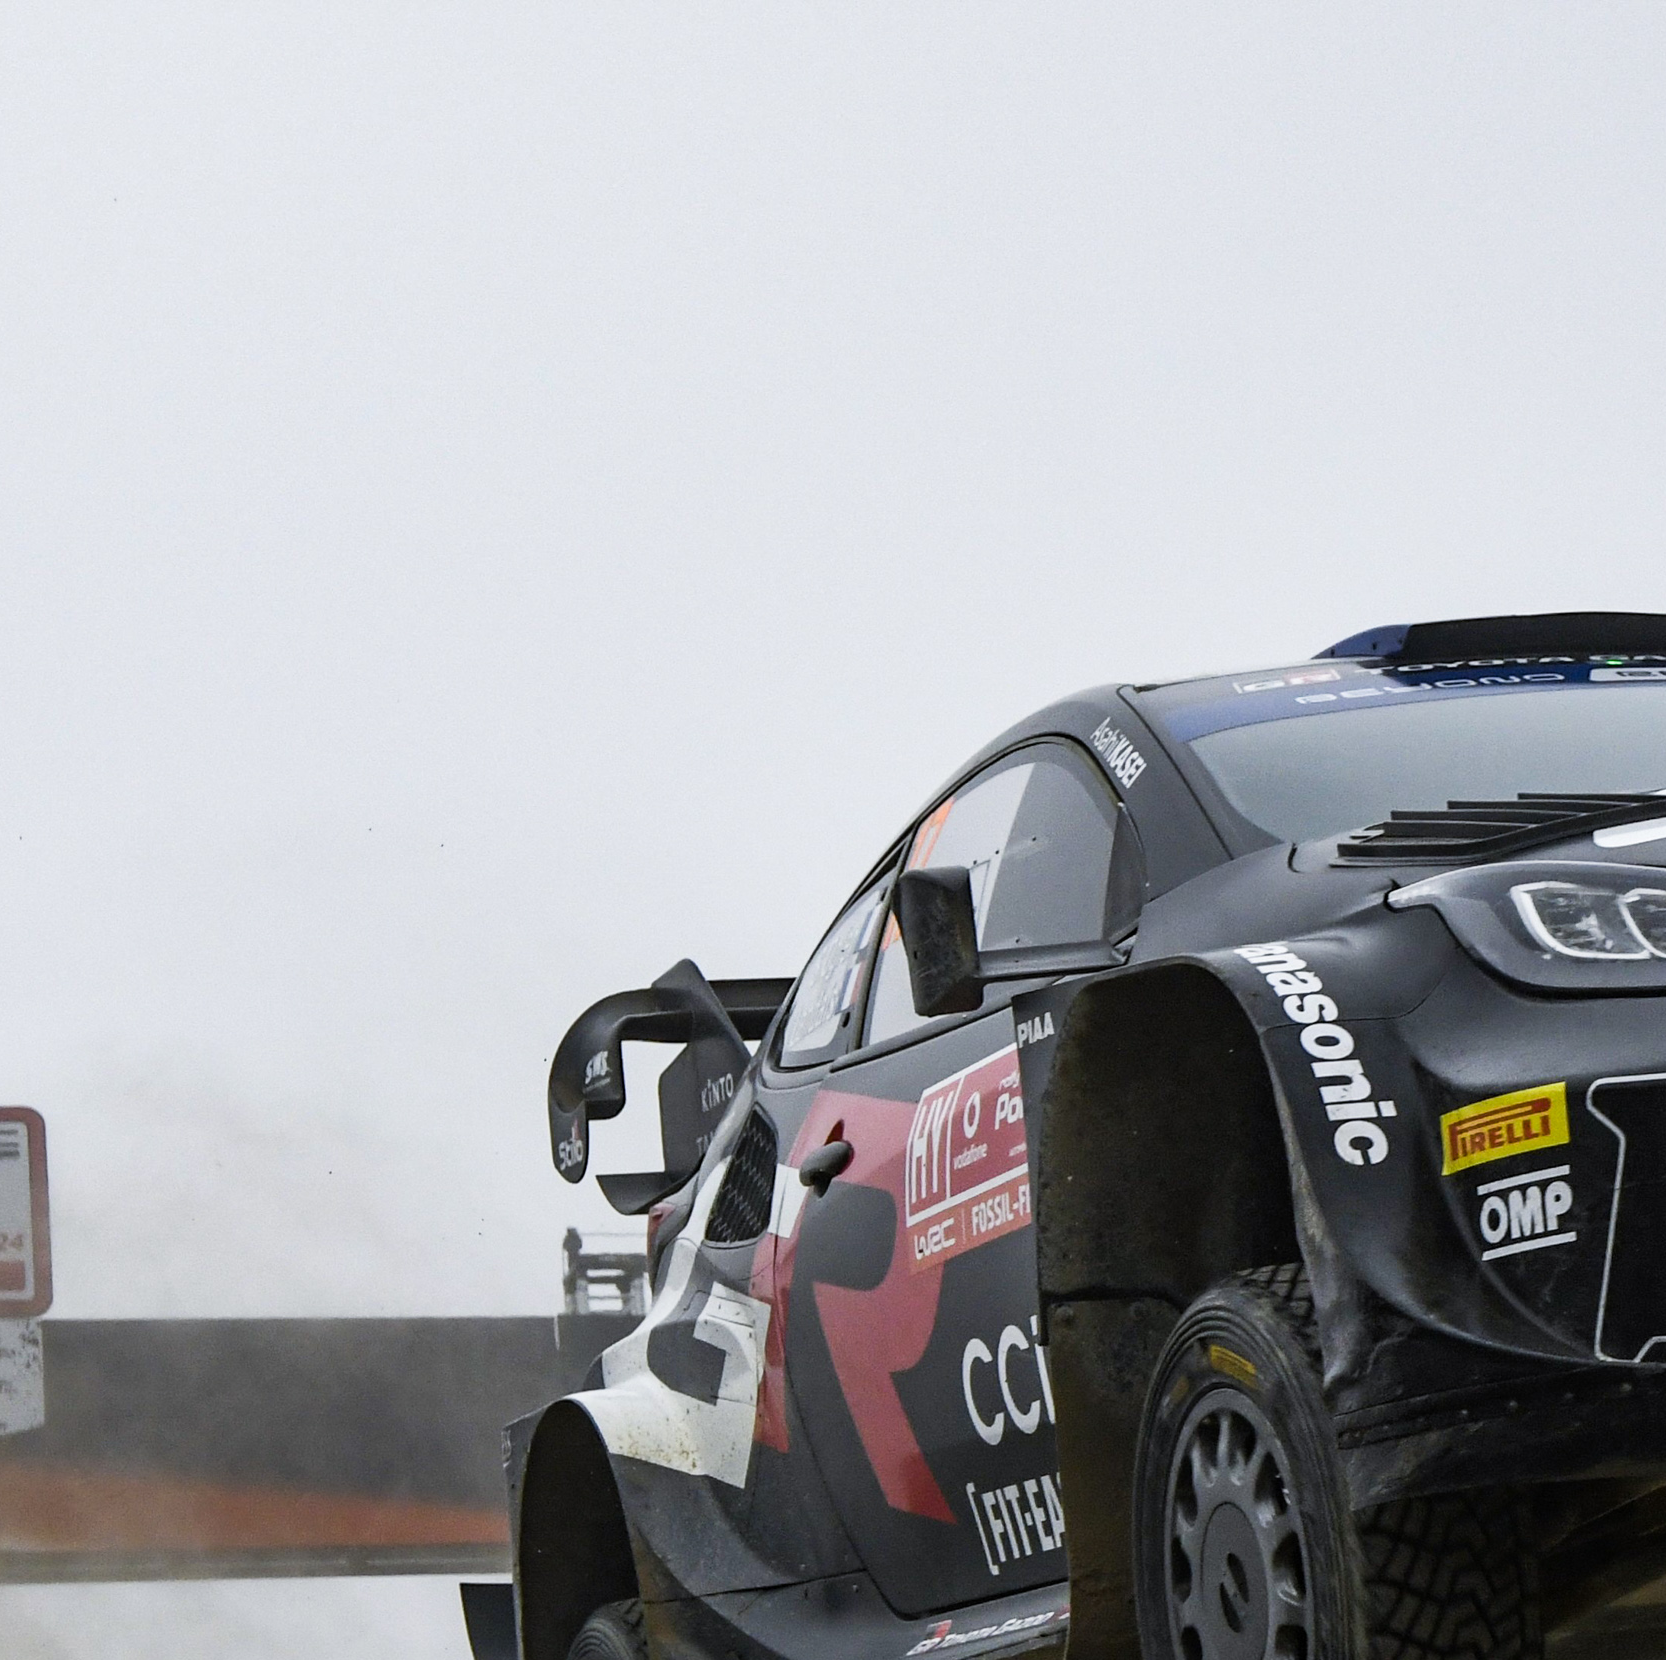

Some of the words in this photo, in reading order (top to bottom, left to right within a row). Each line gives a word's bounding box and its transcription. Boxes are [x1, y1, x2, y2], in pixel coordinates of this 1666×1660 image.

[1354, 655, 1573, 677] TOYOTA
[1090, 716, 1148, 789] AsahiKASEI
[1017, 1012, 1055, 1048] PIAA
[1448, 1097, 1552, 1161] PIRELLI
[1480, 1180, 1573, 1244] OMP
[966, 1472, 1066, 1576] [FIT-EA
